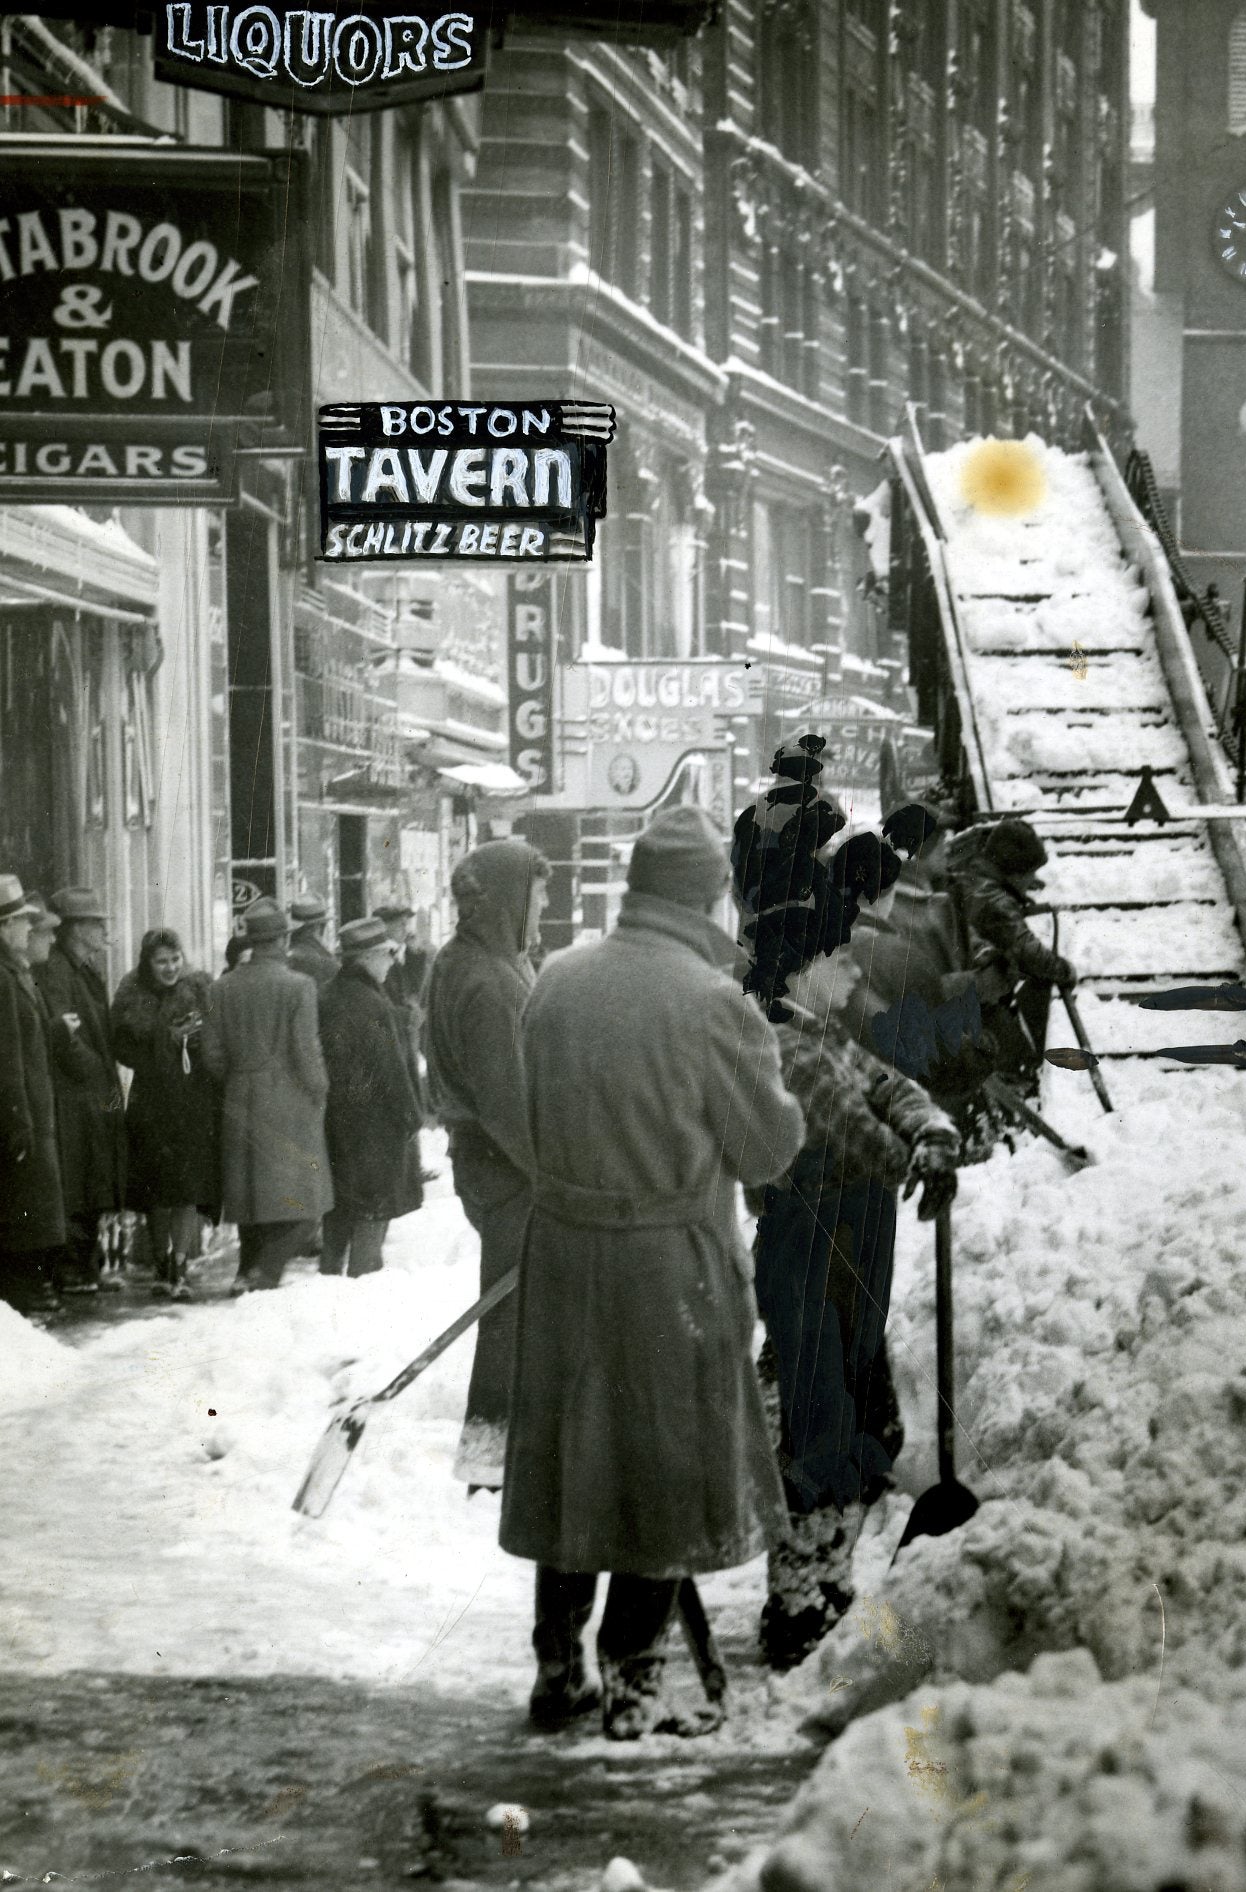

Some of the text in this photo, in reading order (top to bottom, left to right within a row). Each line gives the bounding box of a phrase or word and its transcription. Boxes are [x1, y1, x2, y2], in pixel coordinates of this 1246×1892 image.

[166, 3, 474, 86] LIQUORS
[53, 284, 113, 329] &
[380, 406, 550, 437] BOSTON
[0, 442, 209, 476] IGARS
[325, 446, 572, 508] TAVERN
[325, 521, 545, 557] SCHLITZ BEER
[514, 569, 548, 788] DRUGS
[589, 664, 745, 708] DOUGLAS
